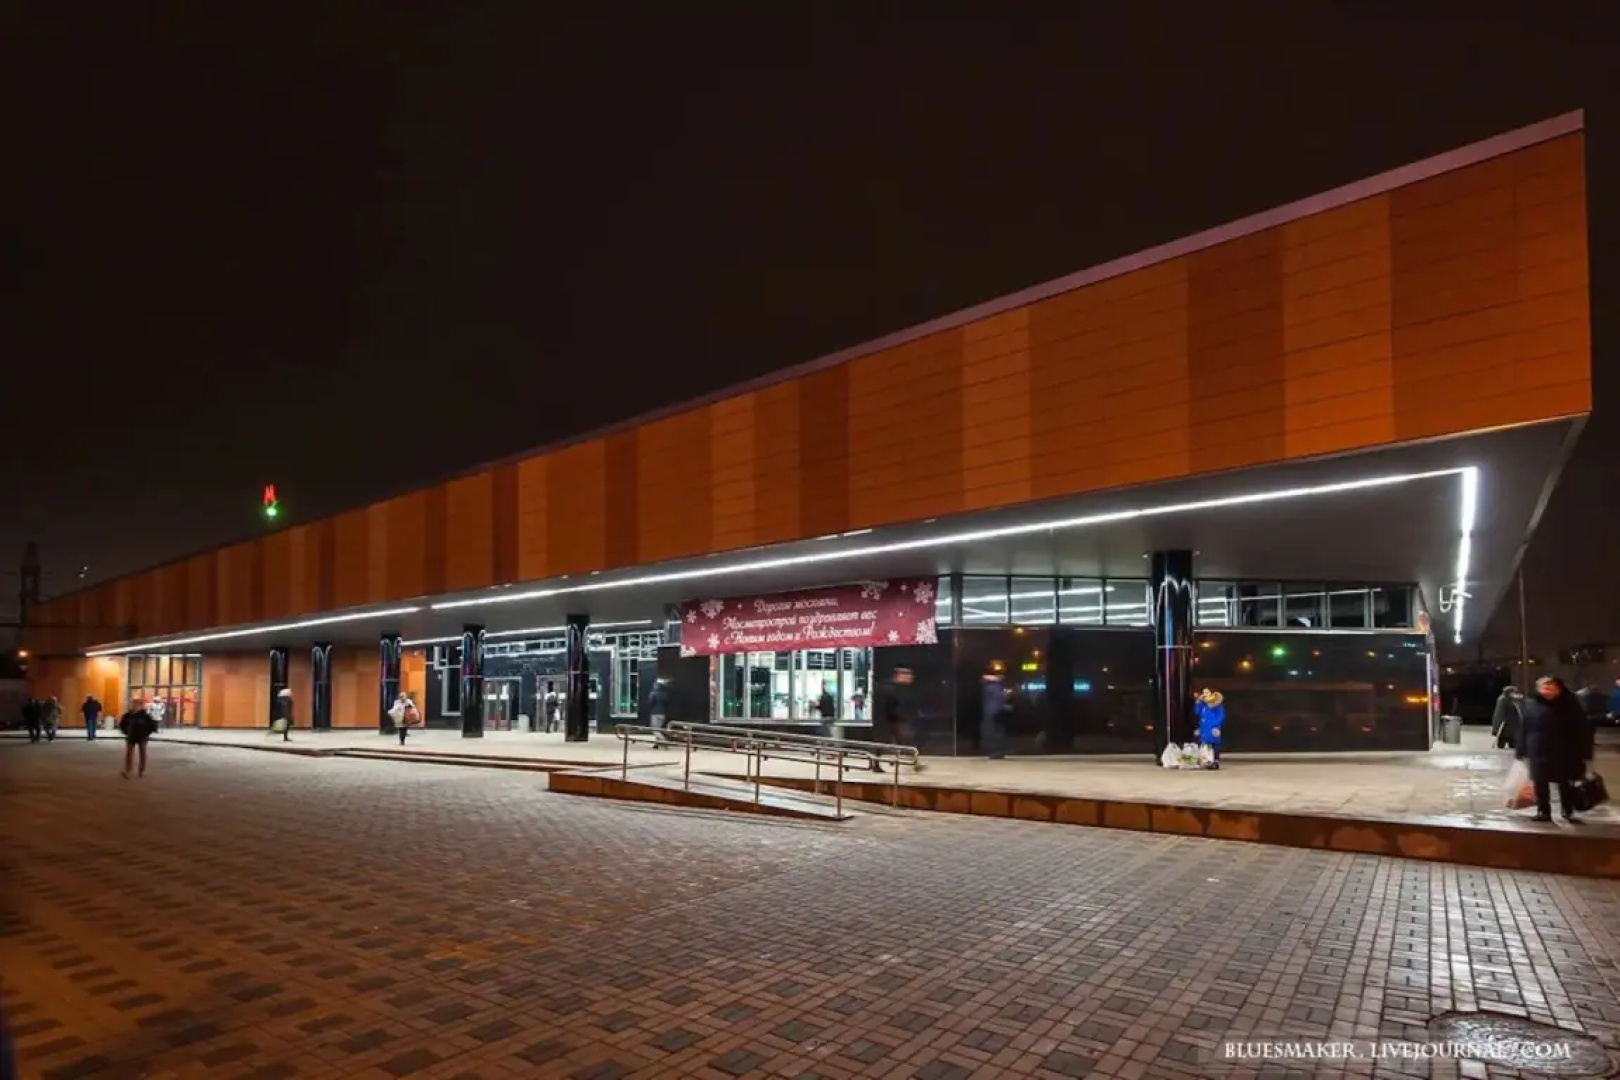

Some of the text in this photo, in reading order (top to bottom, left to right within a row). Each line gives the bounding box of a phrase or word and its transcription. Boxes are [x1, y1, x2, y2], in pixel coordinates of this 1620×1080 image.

[731, 629, 766, 644] Новым
[766, 630, 793, 643] годом
[802, 620, 876, 640] Рождеством!
